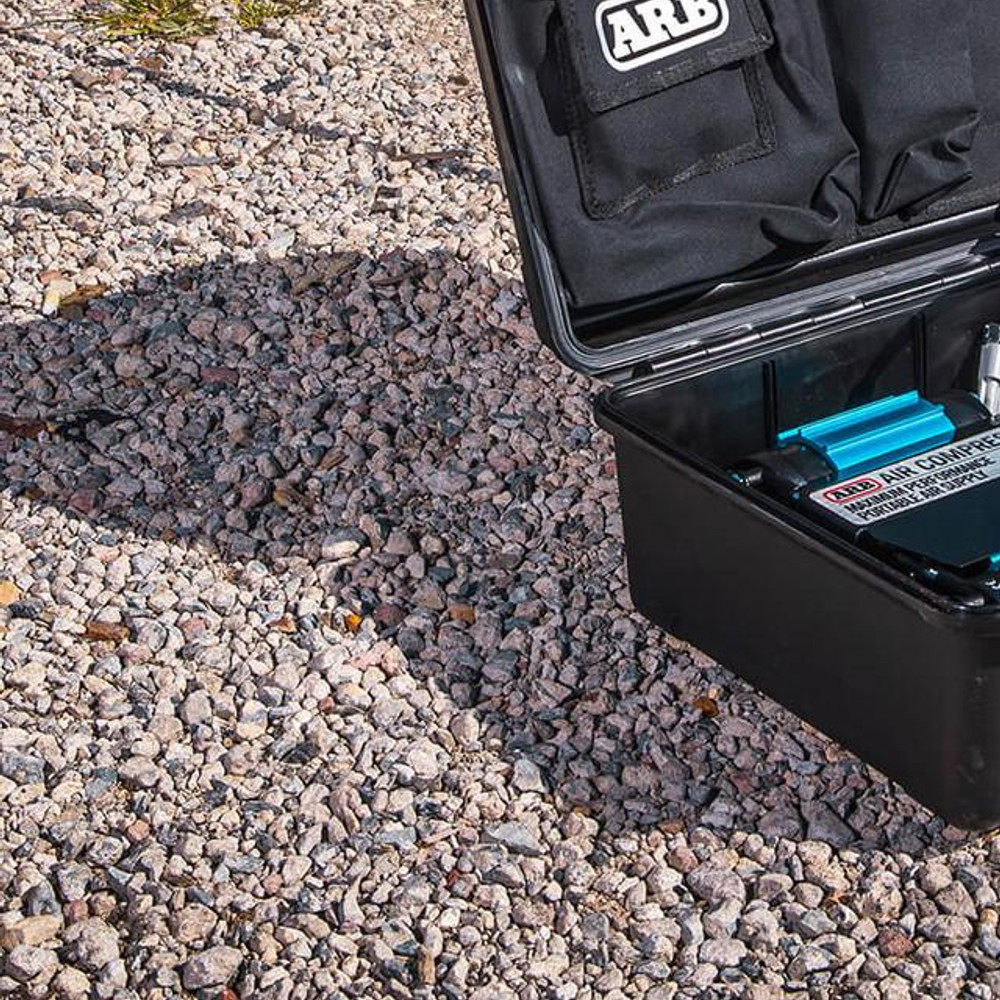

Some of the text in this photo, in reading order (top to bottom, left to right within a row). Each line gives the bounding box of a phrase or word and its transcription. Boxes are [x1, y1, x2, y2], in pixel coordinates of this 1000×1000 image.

[832, 481, 876, 500] ARB
[880, 466, 918, 484] AIR
[844, 456, 995, 514] MAXIMUM PERFORMANCE
[857, 470, 990, 521] PORTABLE AIR SUPPLY
